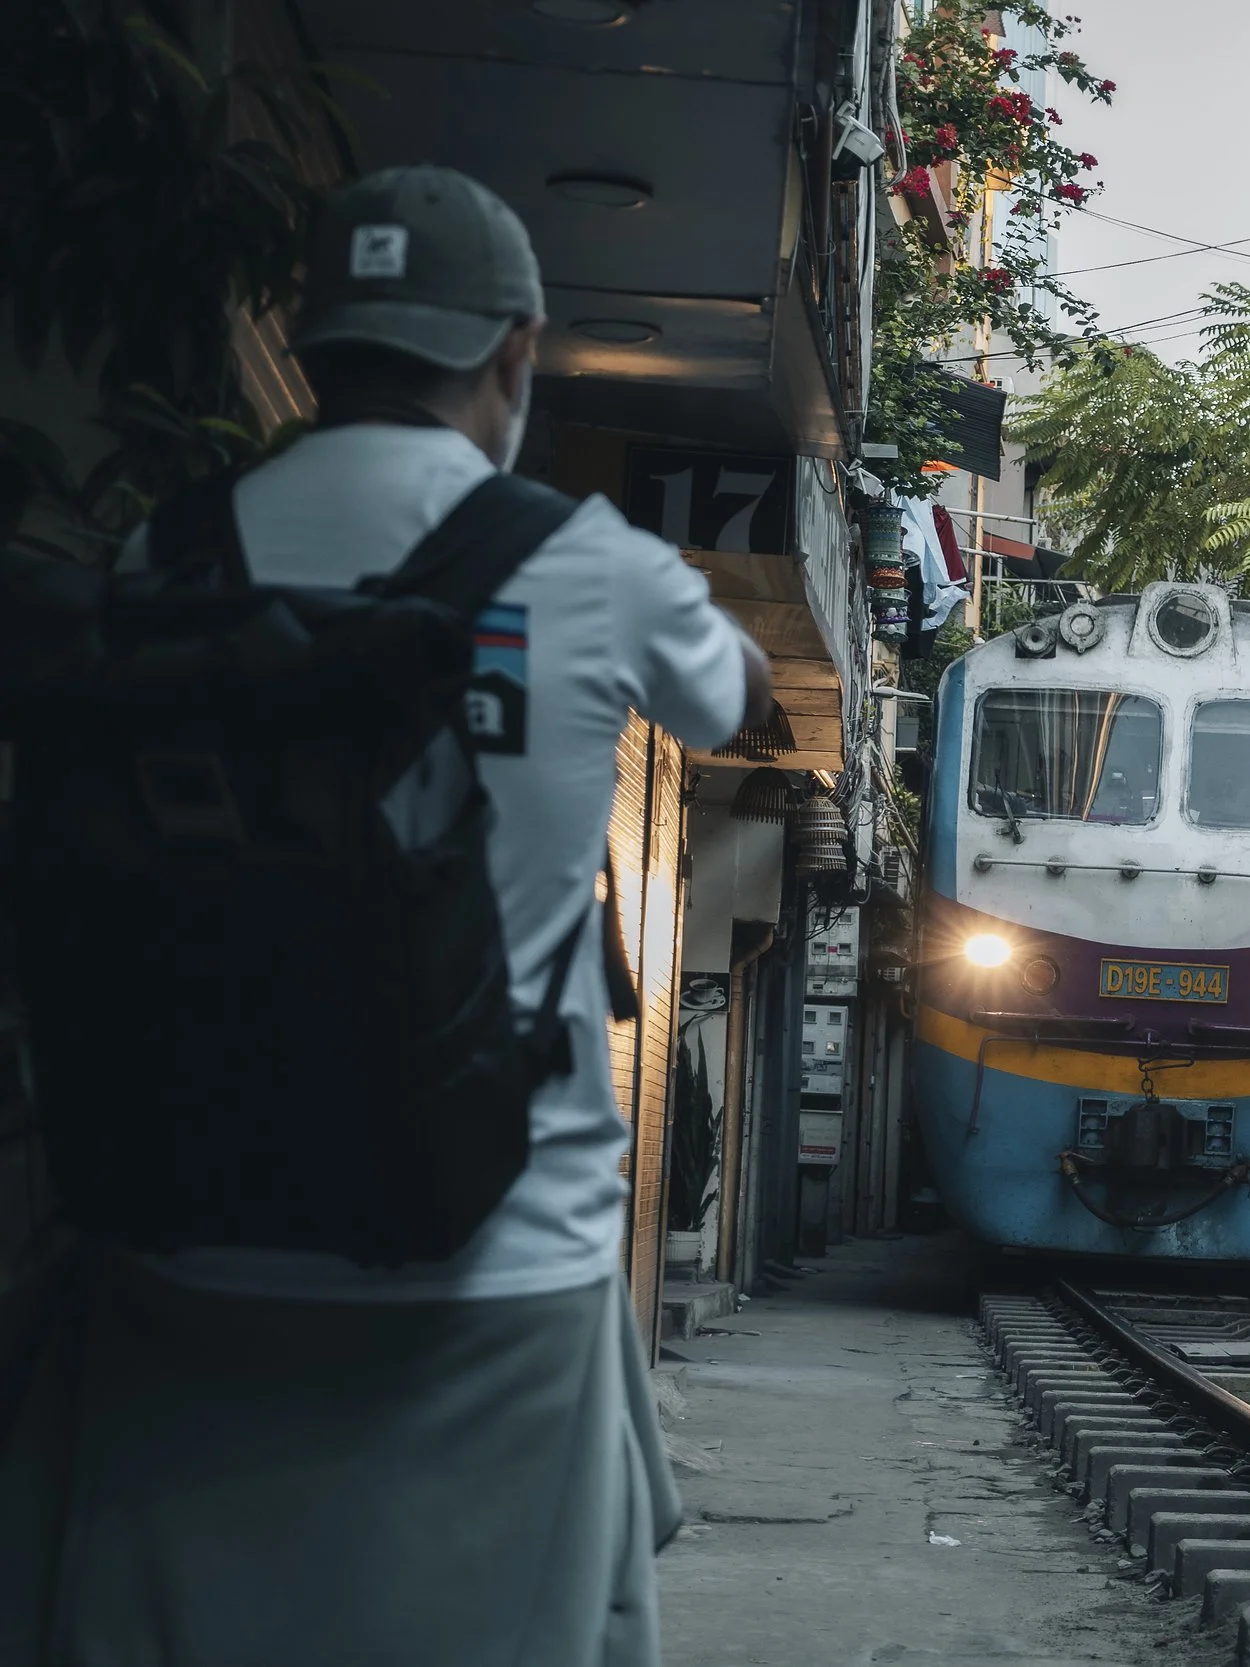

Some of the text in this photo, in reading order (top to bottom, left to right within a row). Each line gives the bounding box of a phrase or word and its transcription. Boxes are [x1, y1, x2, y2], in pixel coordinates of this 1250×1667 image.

[649, 464, 777, 552] 17
[1106, 964, 1162, 995] D19E
[1179, 969, 1222, 998] 944
